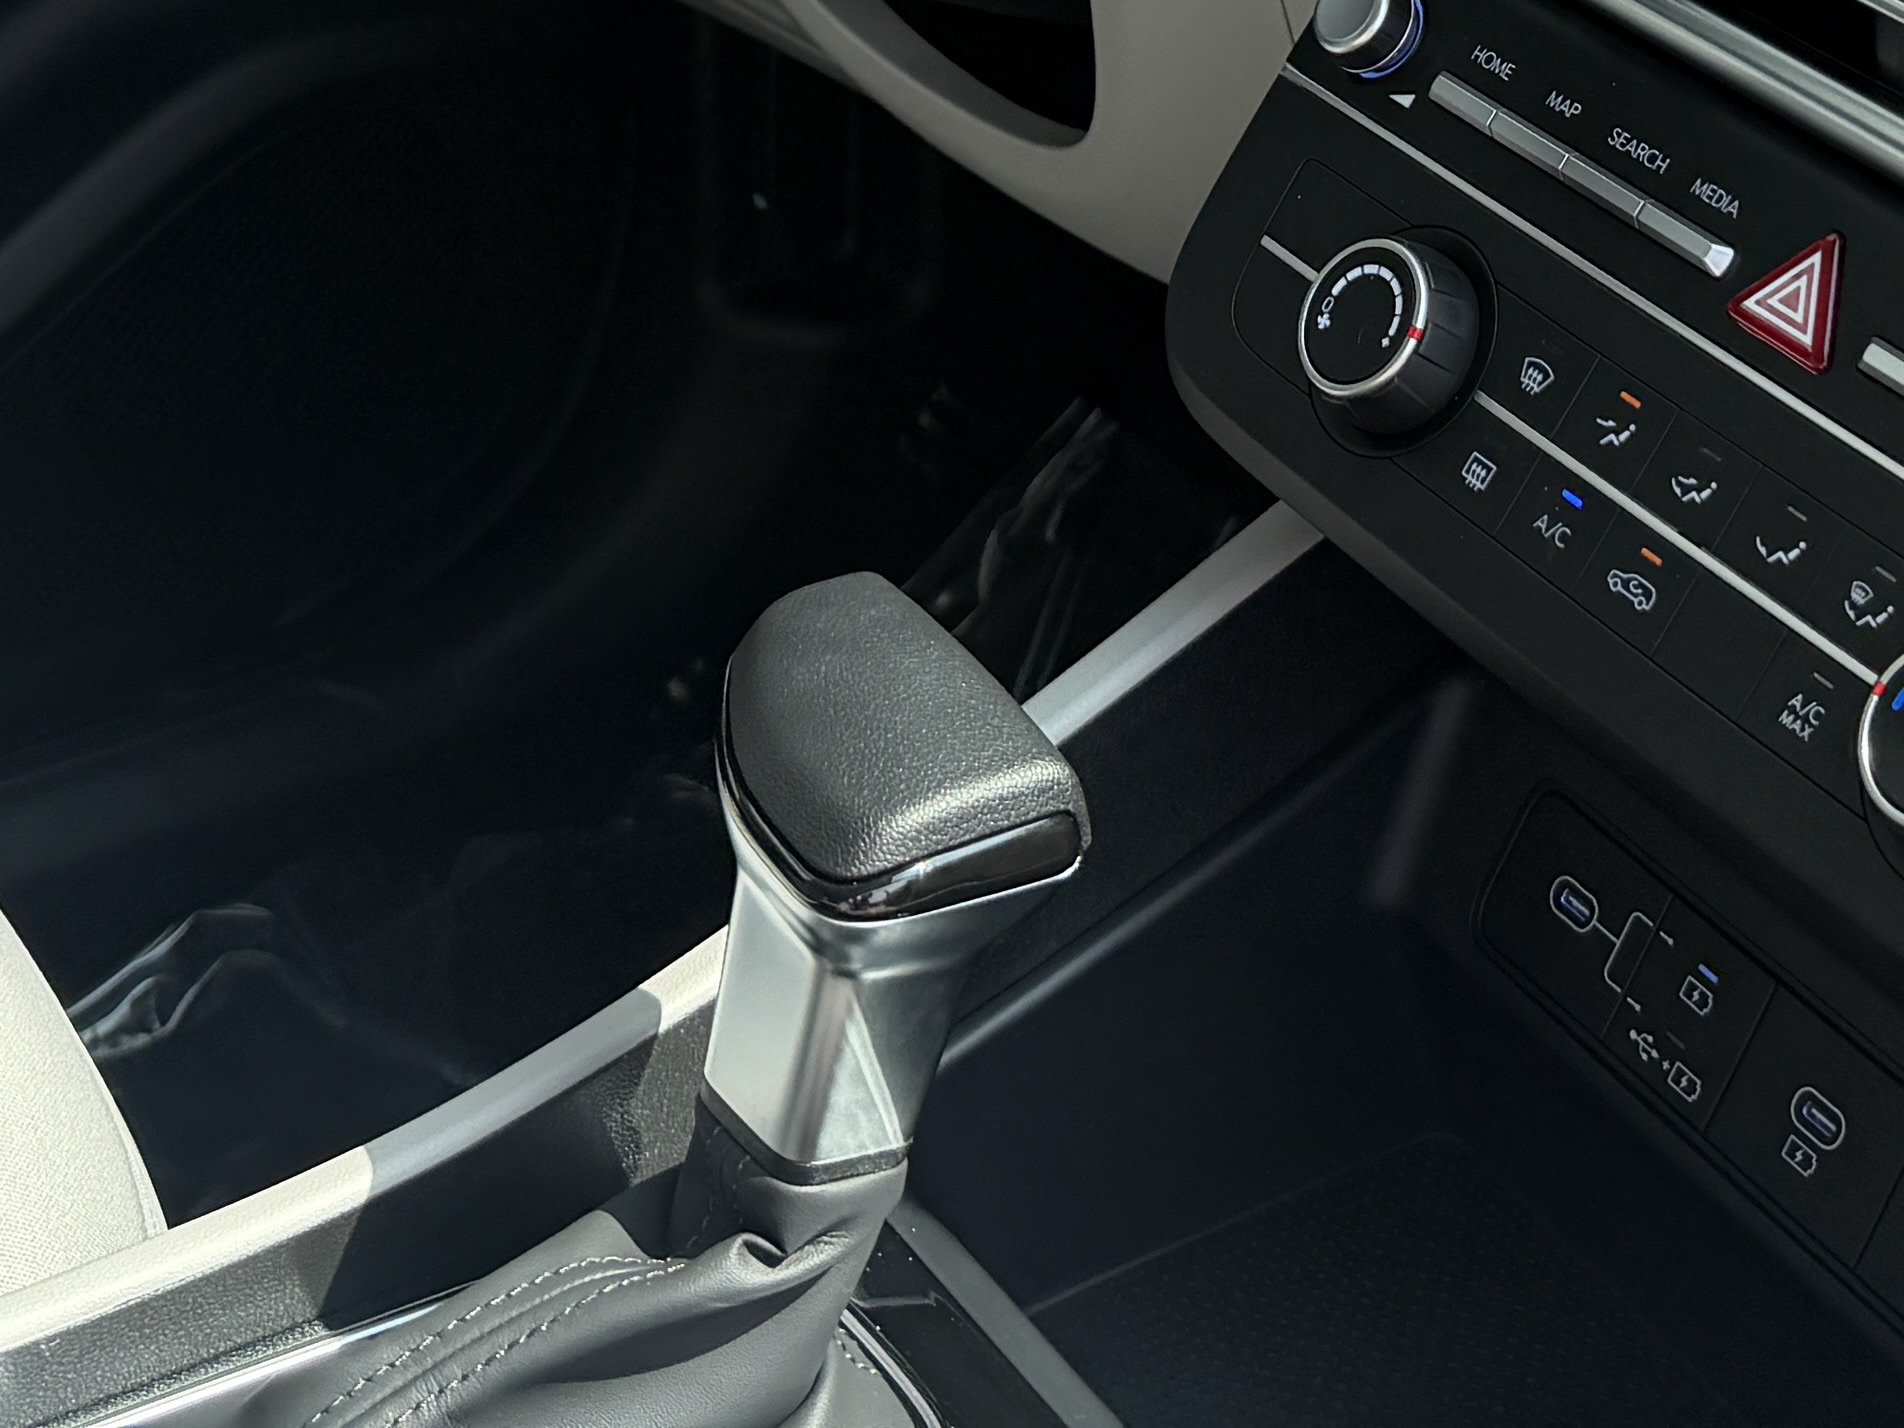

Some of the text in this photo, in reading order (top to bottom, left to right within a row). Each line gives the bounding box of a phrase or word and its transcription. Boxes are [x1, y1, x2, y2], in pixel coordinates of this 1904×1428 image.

[1471, 44, 1516, 82] HOME
[1546, 90, 1582, 119] MAP
[1607, 128, 1671, 175] SEARCH
[1690, 178, 1742, 219] MEDIA
[1532, 513, 1571, 549] A/C
[1778, 709, 1814, 742] MAX
[1786, 693, 1826, 728] A/C
